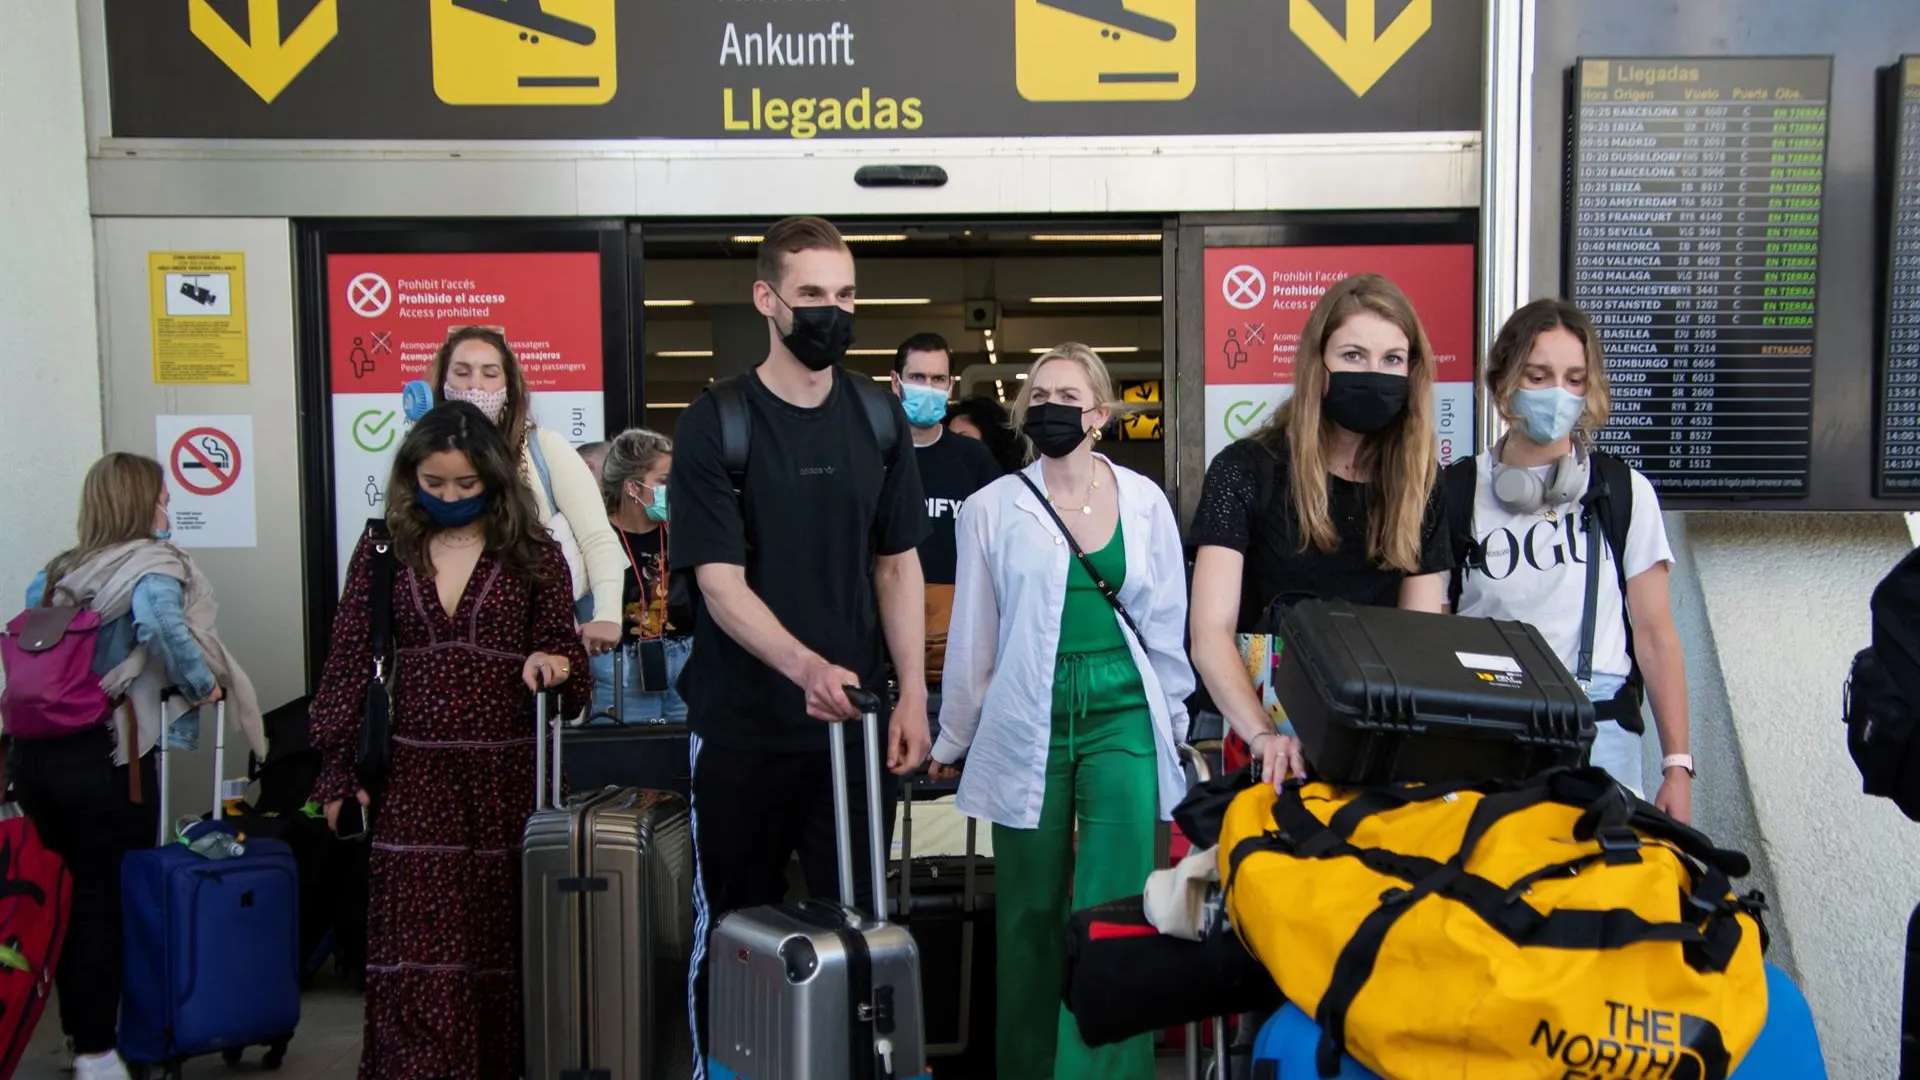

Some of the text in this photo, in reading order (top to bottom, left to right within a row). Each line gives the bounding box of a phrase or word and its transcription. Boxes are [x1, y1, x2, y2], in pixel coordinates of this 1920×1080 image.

[720, 21, 855, 66] Ankunft
[1618, 65, 1700, 86] Llegadas
[1614, 89, 1655, 101] Origen
[1684, 88, 1719, 100] Vuelo
[723, 87, 923, 139] Llegadas
[1613, 106, 1679, 117] BARCELONA
[1612, 121, 1645, 132] IBIZA
[1611, 137, 1657, 147] MADRID
[1610, 152, 1682, 162] DUSSELDORF
[1740, 152, 1748, 162] C
[1580, 167, 1748, 177] 10:20 BARCELONA C
[1610, 182, 1642, 192] IBIZA
[1738, 182, 1747, 192] C
[1579, 197, 1607, 207] 10:30
[1609, 197, 1678, 207] AMSTERDAM
[1738, 197, 1746, 207] C
[1608, 211, 1673, 222] FRANKFURT
[1737, 211, 1745, 222] C
[1607, 226, 1653, 237] SEVILLA
[1736, 226, 1745, 237] C
[1767, 227, 1781, 237] EN
[1577, 242, 1605, 251] 10:40
[1606, 242, 1661, 251] MENORCA
[1678, 242, 1691, 251] IB
[1735, 242, 1744, 251] C
[1766, 242, 1780, 252] EN
[1782, 242, 1818, 252] TIERRA
[1576, 256, 1604, 266] 10:40
[1606, 256, 1662, 266] VALENCIA
[1678, 256, 1690, 266] IB
[1735, 256, 1742, 266] C
[1765, 257, 1779, 267] EN
[1781, 257, 1817, 267] TIERRA
[1273, 271, 1313, 281] Prohibit
[1576, 271, 1604, 280] 10:40
[1606, 271, 1651, 280] MALAGA
[1734, 271, 1742, 280] C
[1764, 271, 1778, 282] EN
[1781, 271, 1816, 282] TIERRA
[398, 279, 438, 290] Prohibit
[1273, 285, 1326, 296] Prohibido
[1575, 285, 1603, 295] 10:45
[1605, 285, 1679, 295] MANCHESTER
[1733, 285, 1741, 295] C
[1764, 287, 1777, 297] EN
[1780, 287, 1815, 297] TIERRA
[399, 293, 505, 304] Prohibido el acceso
[1273, 299, 1308, 310] Access
[1575, 300, 1814, 311] 10:50 STANSTED RYR 1202 C EN TIERRA
[399, 307, 490, 319] Access prohibited
[1604, 314, 1652, 324] BILLUND
[1675, 314, 1690, 324] CAT
[1732, 314, 1740, 324] C
[1762, 316, 1776, 326] EN
[1778, 316, 1813, 326] TIERRA
[1604, 329, 1650, 339] BASILEA
[400, 341, 441, 351] Acompany
[1603, 344, 1811, 354] VALENCIA RYR 7214 RETRASADO
[520, 351, 560, 362] pasajeros
[1273, 355, 1296, 364] Peopl
[400, 363, 427, 373] People
[530, 364, 540, 373] up
[542, 363, 586, 374] passengers
[1673, 358, 1688, 368] RYR
[1889, 358, 1918, 368] 13:45
[1672, 373, 1685, 382] UX
[1691, 373, 1715, 382] 6013
[1608, 388, 1652, 397] RESDEN
[1691, 388, 1714, 397] 2600
[1441, 398, 1455, 427] info
[1671, 402, 1687, 412] RYR
[1694, 402, 1713, 412] 278
[572, 407, 586, 436] info
[1671, 416, 1683, 426] UX
[1689, 416, 1712, 426] 4532
[1600, 431, 1712, 441] IBIZA IB 8527
[1886, 431, 1914, 440] 14:00
[1441, 439, 1452, 467] cov
[1669, 445, 1682, 455] LX
[1689, 445, 1712, 455] 2152
[1885, 446, 1913, 455] 14:10
[1669, 459, 1711, 469] DE 1512
[1884, 460, 1912, 469] 14:10
[924, 497, 963, 519] IFY
[1463, 512, 1612, 581] OGU
[1604, 999, 1674, 1046] THE
[1529, 1018, 1675, 1079] NORTH
